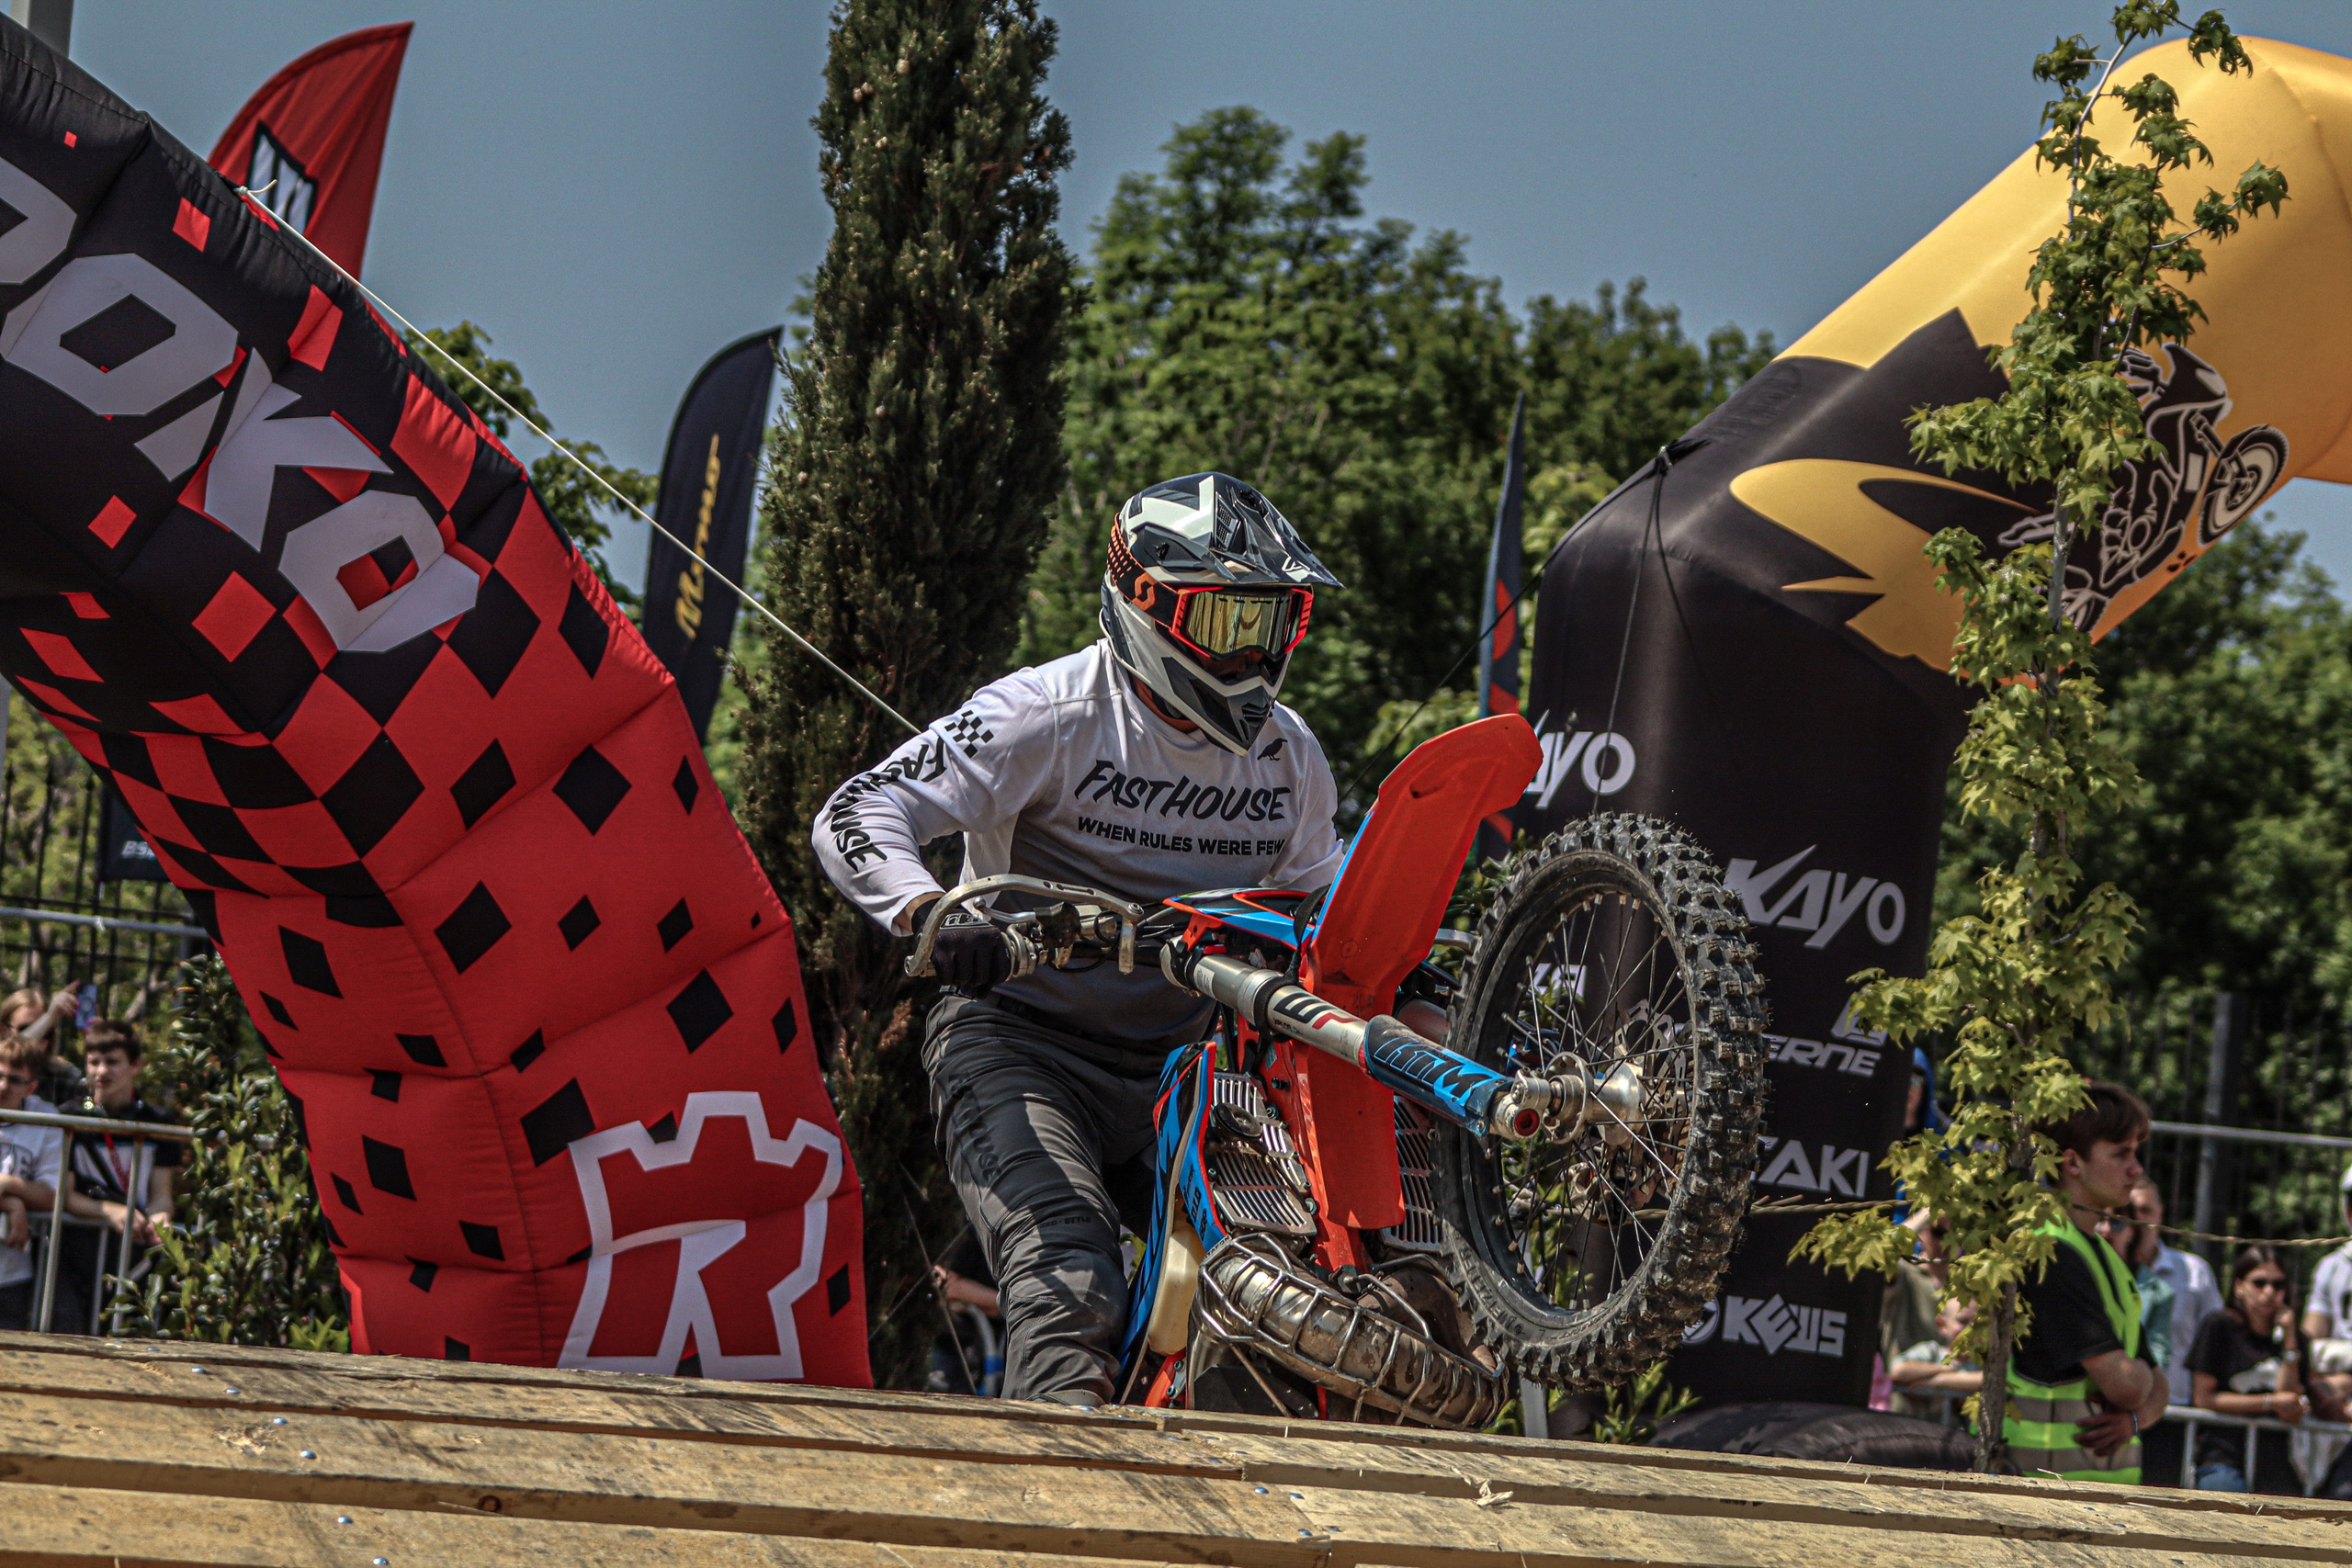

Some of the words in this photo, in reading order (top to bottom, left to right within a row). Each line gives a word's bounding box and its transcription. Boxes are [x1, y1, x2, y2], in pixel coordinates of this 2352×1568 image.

[1524, 708, 1636, 807] AYO
[1074, 759, 1291, 822] FASTHOUSE
[1078, 817, 1136, 844] WHEN
[1139, 830, 1193, 853] RULES
[1198, 838, 1251, 855] WERE
[1724, 843, 1906, 951] KAYO
[1374, 1036, 1495, 1100] KTM
[1761, 1032, 1882, 1077] ERNE
